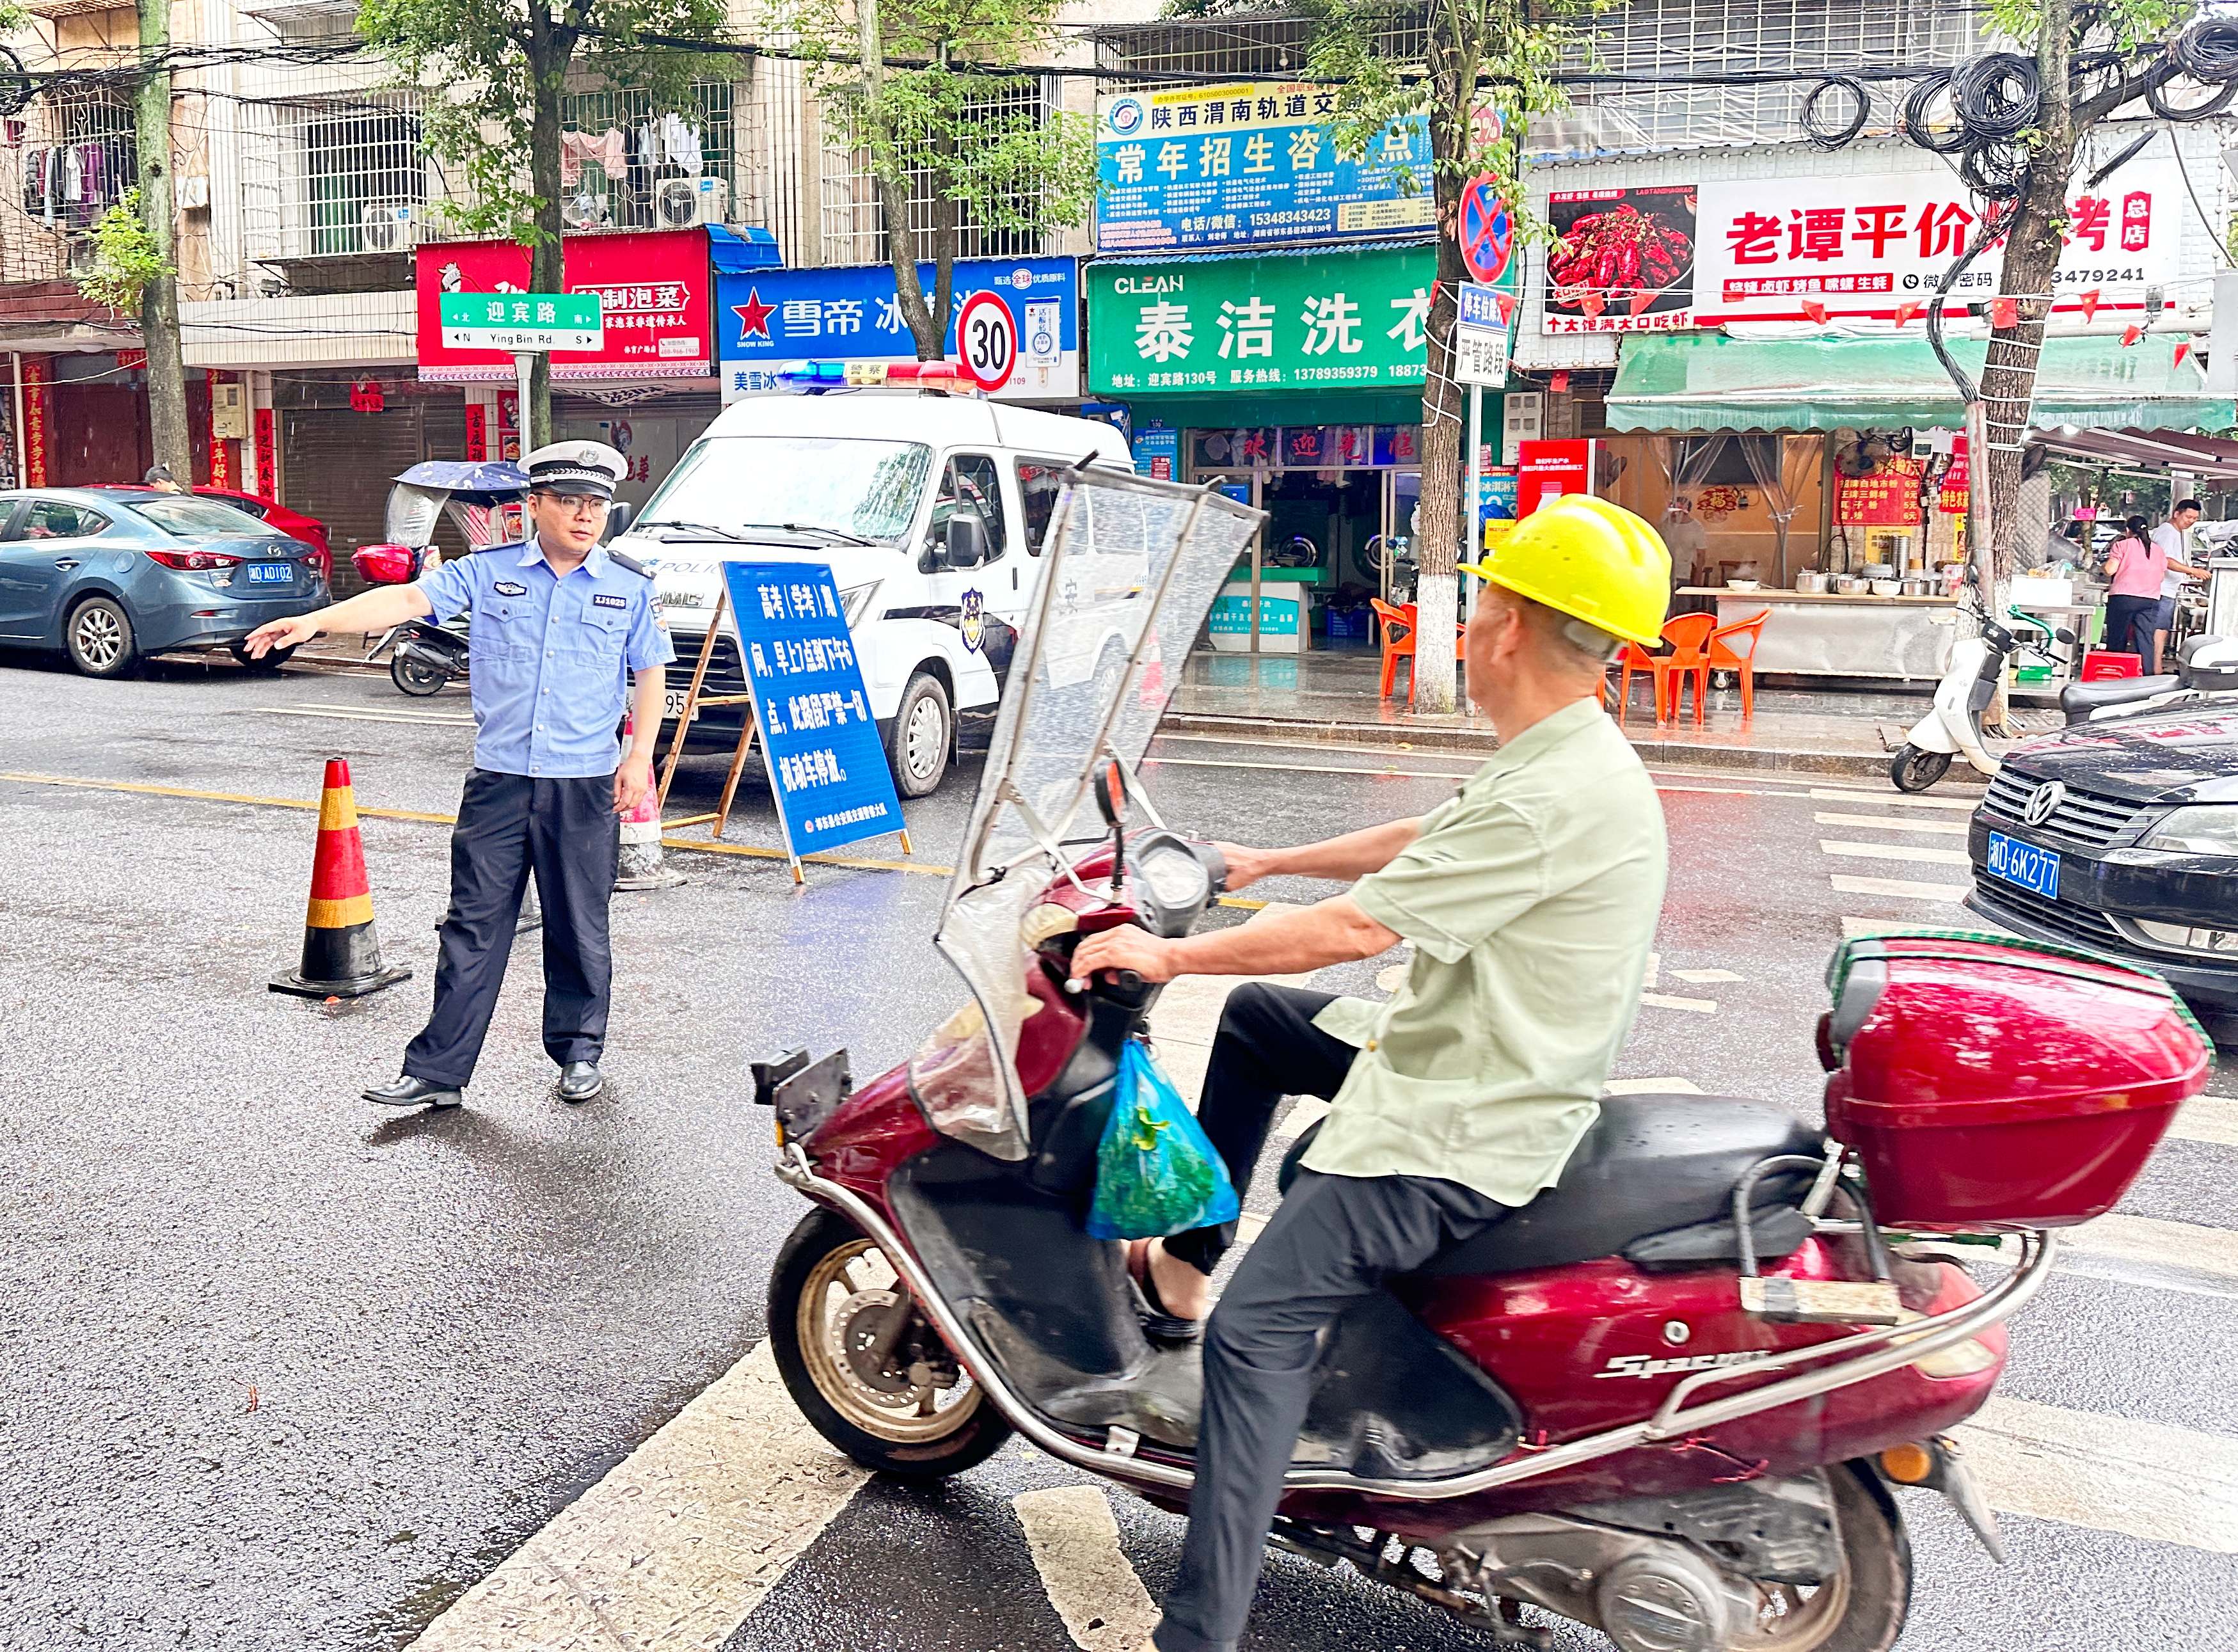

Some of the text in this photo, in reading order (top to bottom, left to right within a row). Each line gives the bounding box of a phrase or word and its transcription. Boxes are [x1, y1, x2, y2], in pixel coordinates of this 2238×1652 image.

[1276, 83, 1342, 94] 全国职业
[1726, 195, 2111, 264] 老谭平价烤
[2123, 199, 2149, 245] 总店
[1115, 275, 1184, 294] CLEAN
[1761, 280, 1790, 292] 卤虾
[1793, 278, 1821, 292] 烤鱼
[1857, 275, 1888, 290] 生蚝
[579, 287, 680, 310] 制泡菜
[461, 301, 583, 324] 北 迎宾路 南
[782, 299, 863, 337] 雪帝
[1134, 289, 1430, 363] 泰洁洗衣
[463, 333, 470, 342] N
[490, 333, 513, 345] Ying
[516, 334, 532, 344] Bin
[576, 336, 582, 344] S
[972, 319, 1005, 370] 30
[1460, 338, 1504, 376] 严管路段
[734, 370, 782, 391] 美雪冰
[850, 364, 882, 375] 警察
[1112, 372, 1217, 388] 地址：迎宾路130号
[1230, 366, 1378, 384] 服务热线：13789359379
[594, 596, 626, 607] XJ1025
